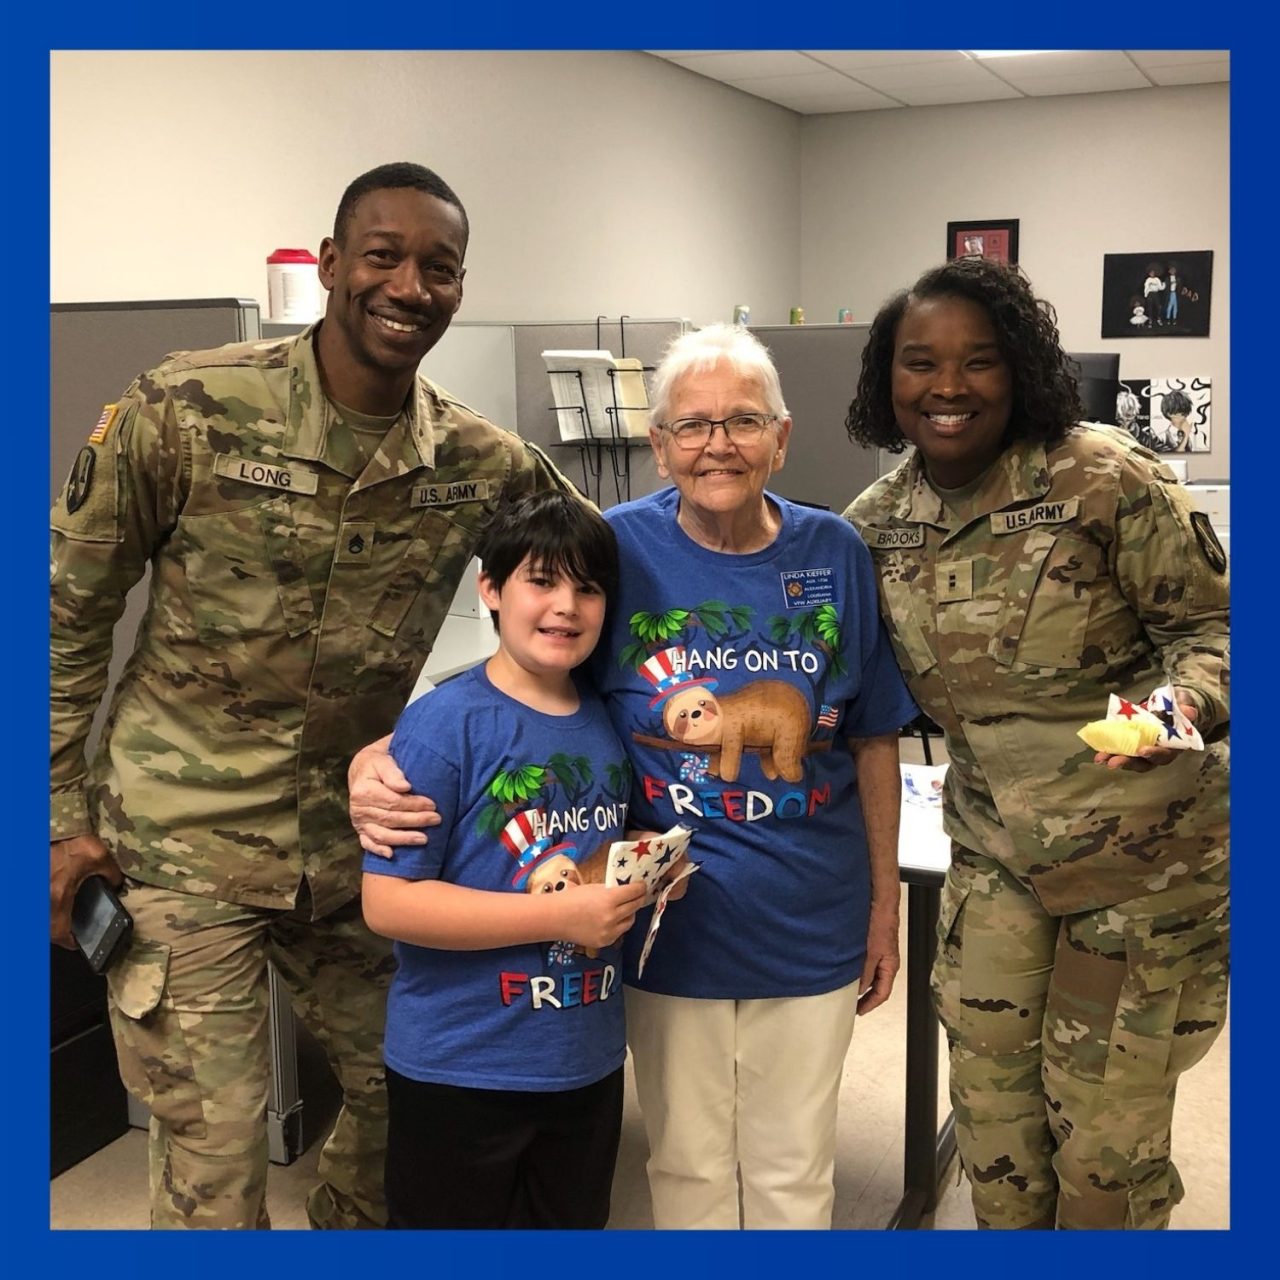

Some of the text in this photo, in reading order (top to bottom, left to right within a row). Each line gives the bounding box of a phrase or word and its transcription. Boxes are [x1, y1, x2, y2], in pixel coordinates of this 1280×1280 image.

[239, 463, 292, 488] LONG
[420, 484, 478, 504] U.S. ARMY
[1029, 503, 1066, 524] ARMY
[877, 531, 921, 546] BROOKS
[671, 647, 819, 674] HANG ON TO
[642, 776, 832, 822] FREEDOM
[532, 802, 629, 838] HANG ON T
